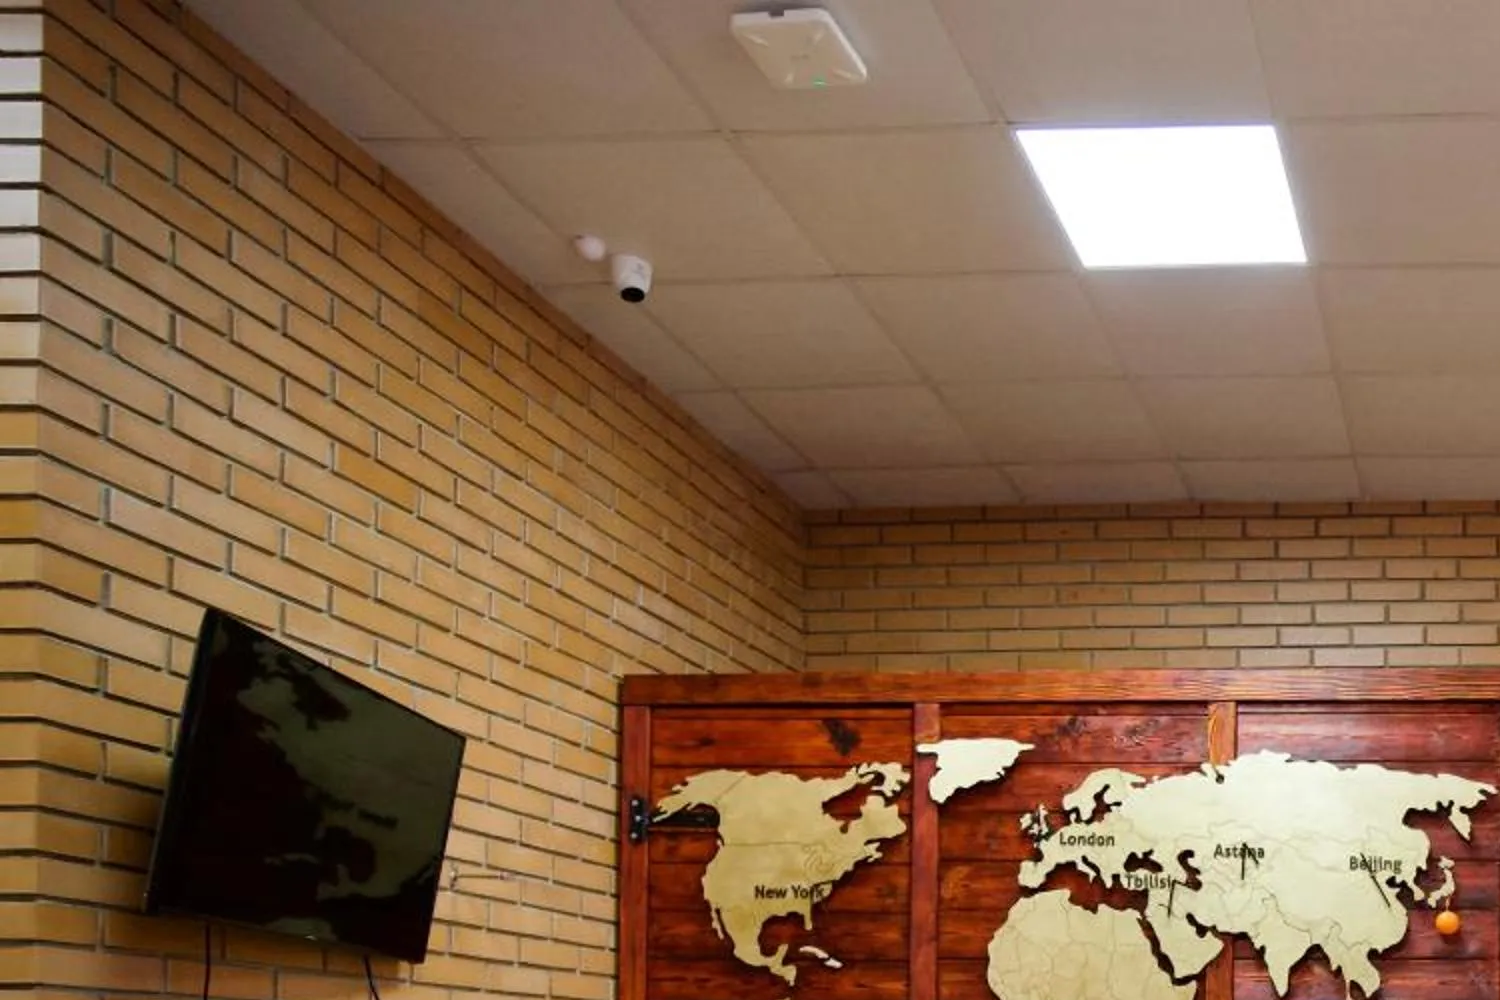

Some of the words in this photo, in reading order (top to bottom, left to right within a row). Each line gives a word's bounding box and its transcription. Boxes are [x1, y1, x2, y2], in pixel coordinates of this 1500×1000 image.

[1059, 832, 1115, 846] London
[1214, 844, 1265, 859] Astana
[1349, 857, 1402, 874] Beijing
[1126, 874, 1172, 889] Tbilisi
[754, 884, 787, 899] New
[791, 884, 824, 899] York
